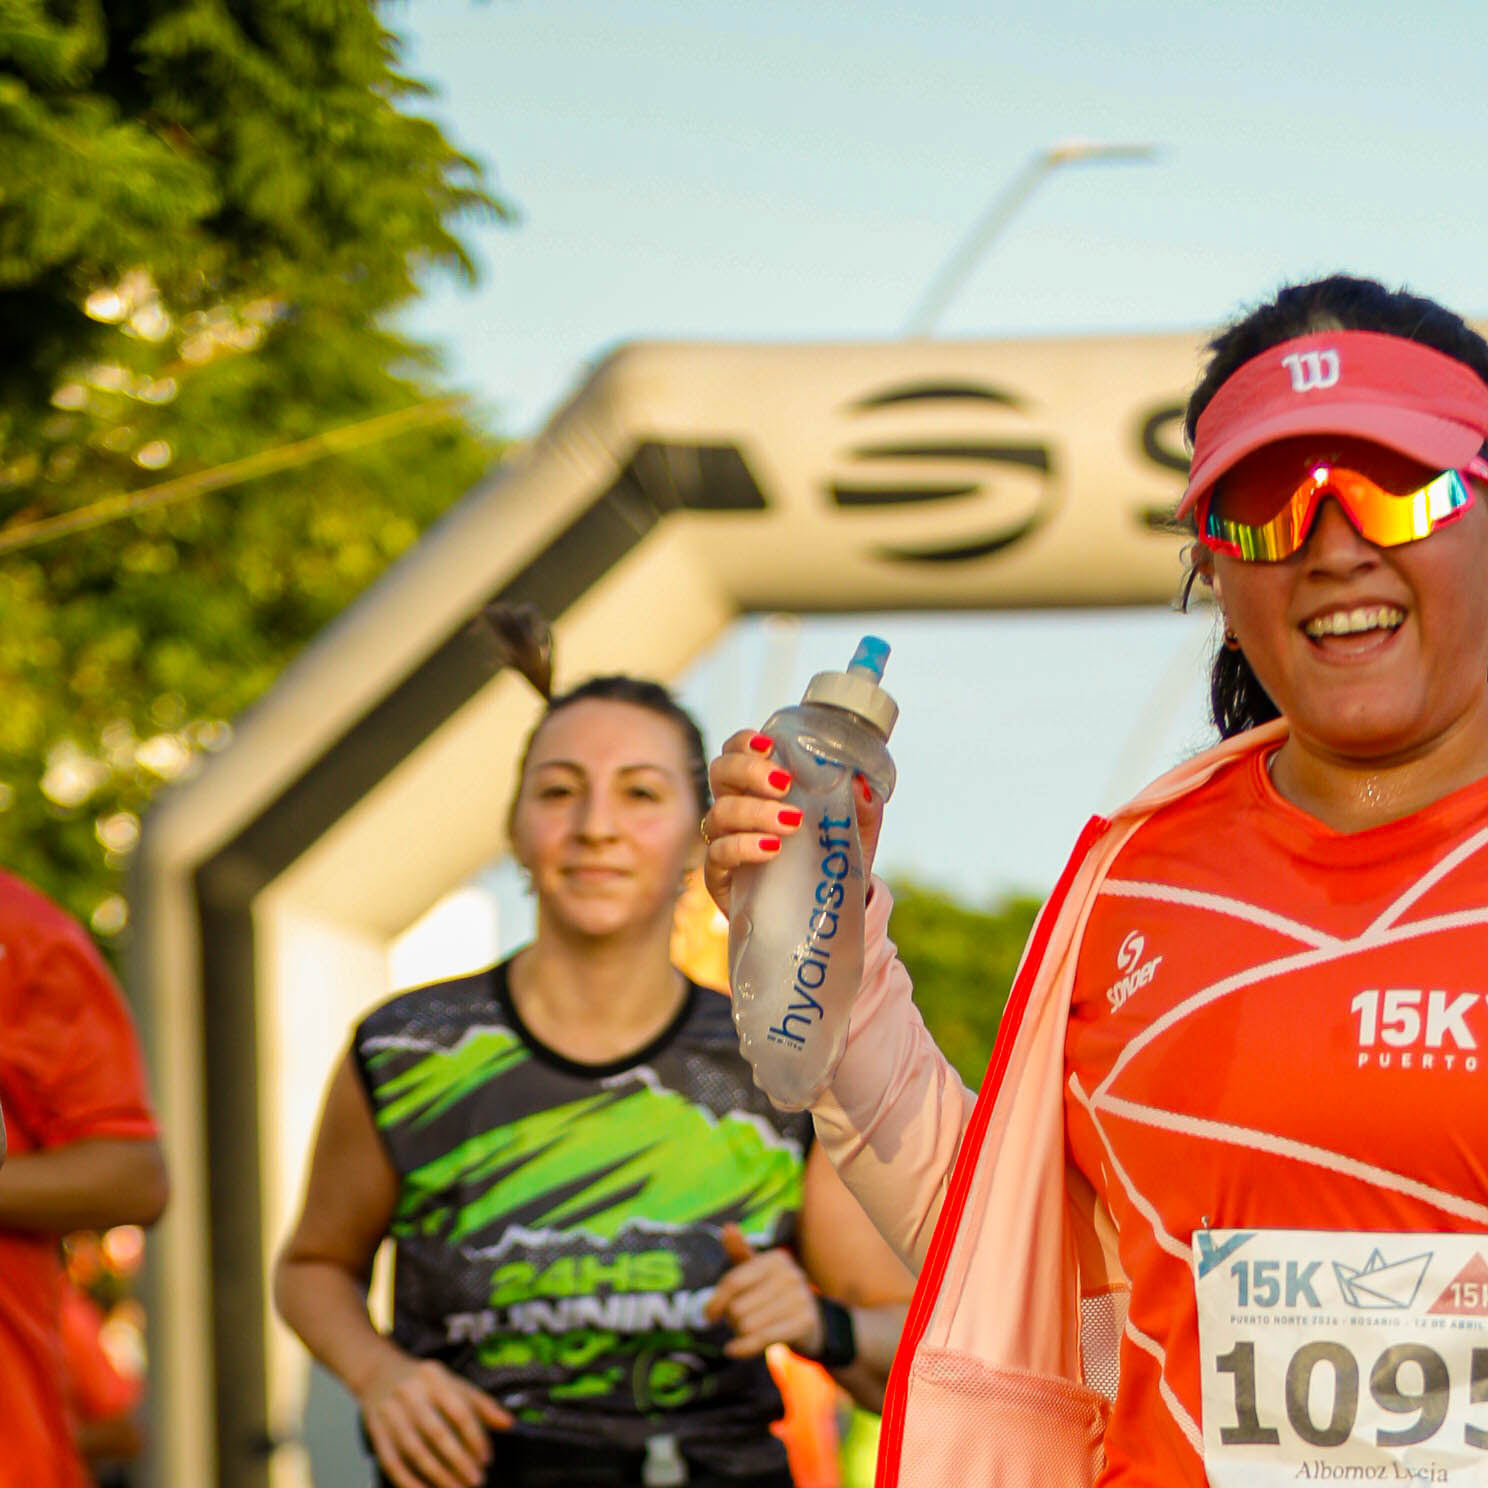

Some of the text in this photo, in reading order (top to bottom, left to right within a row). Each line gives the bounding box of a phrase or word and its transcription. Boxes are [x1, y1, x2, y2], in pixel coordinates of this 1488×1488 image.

[769, 808, 853, 1043] hydrasoft
[1351, 989, 1480, 1050] 15K
[1230, 1260, 1322, 1308] 15K
